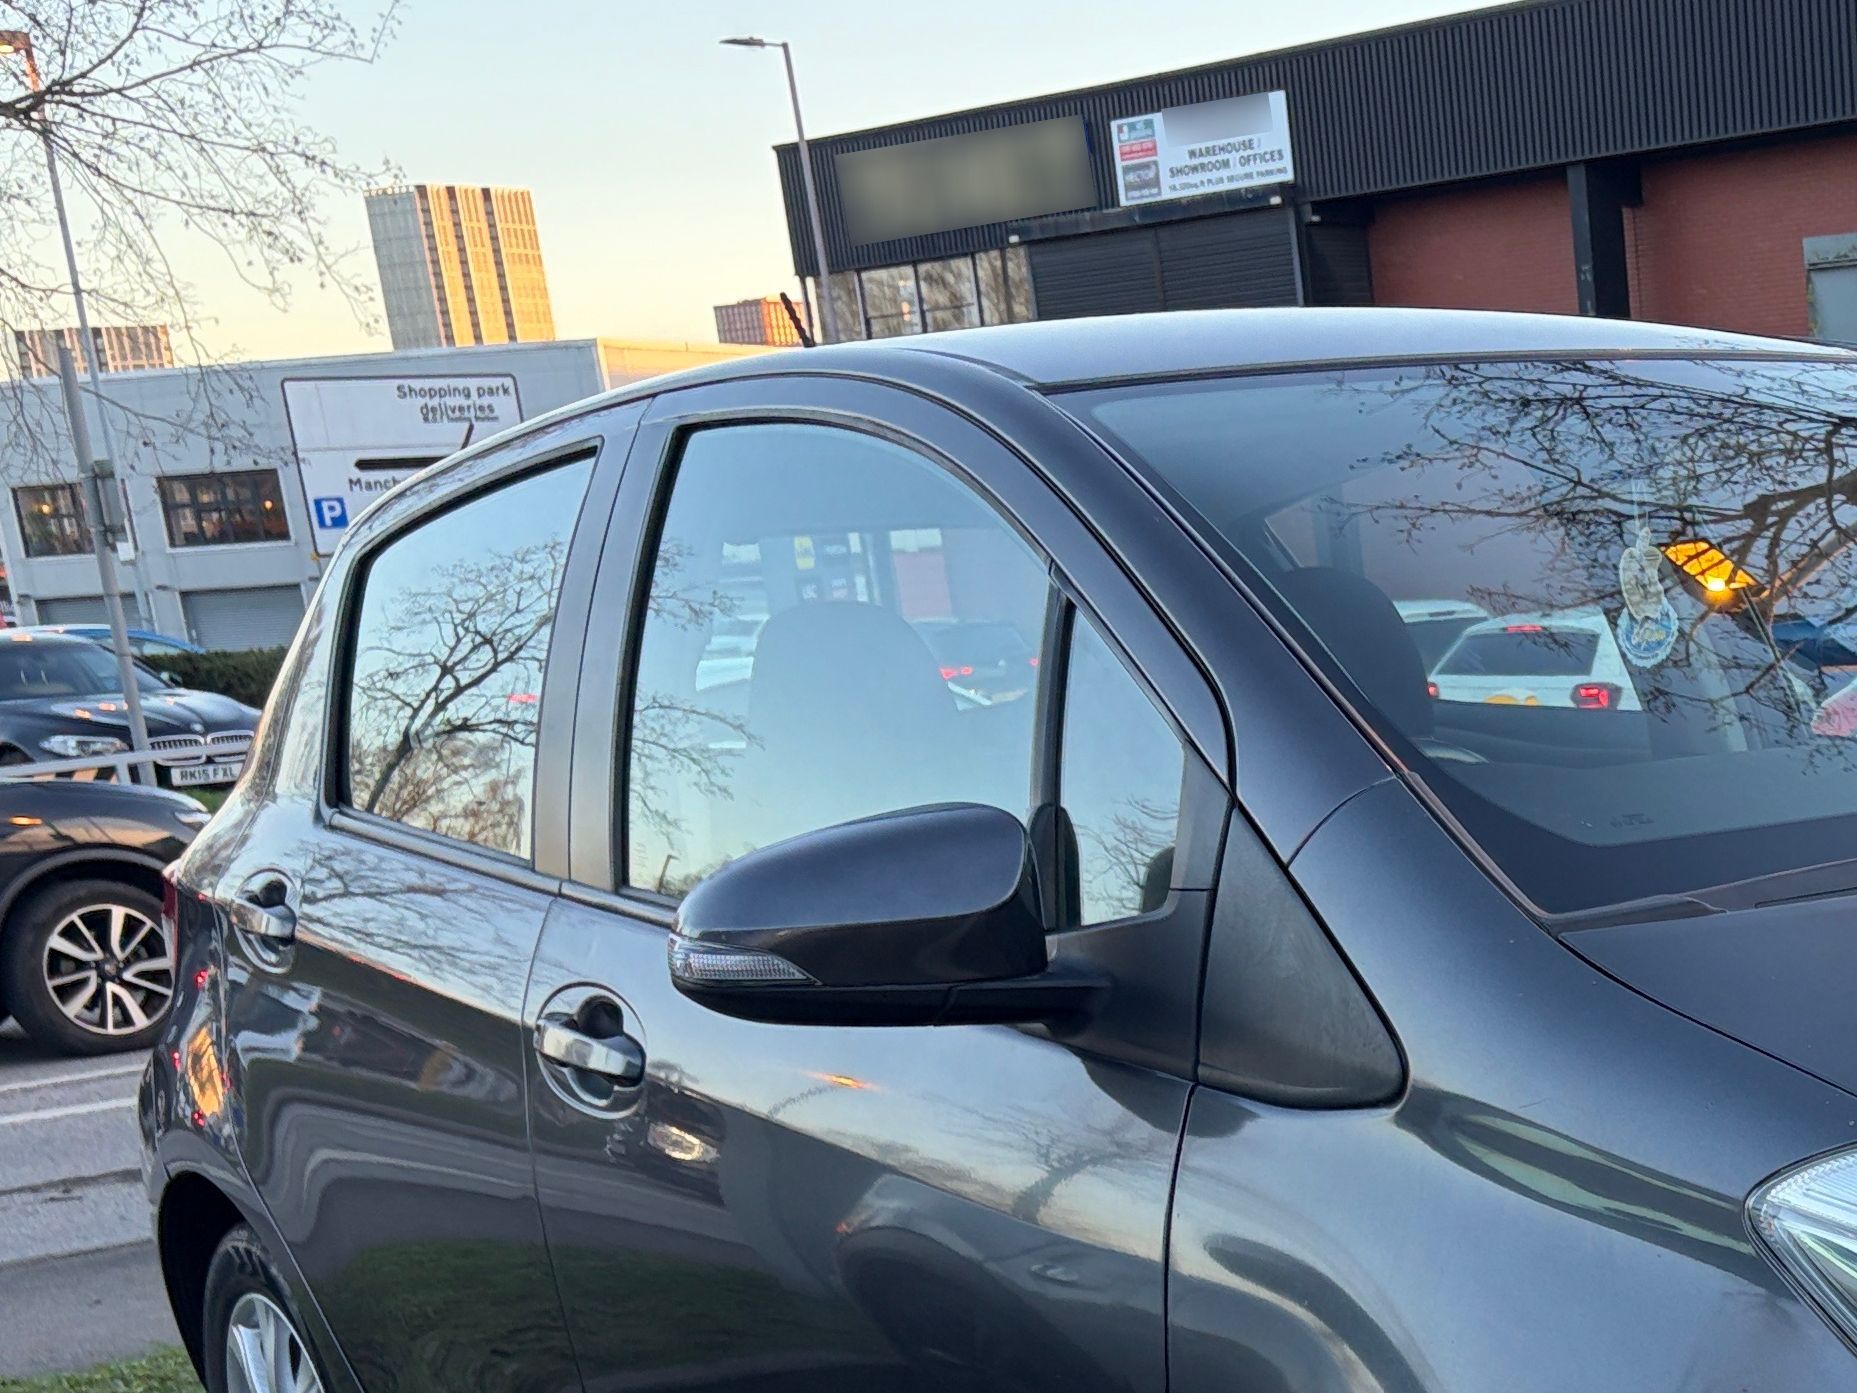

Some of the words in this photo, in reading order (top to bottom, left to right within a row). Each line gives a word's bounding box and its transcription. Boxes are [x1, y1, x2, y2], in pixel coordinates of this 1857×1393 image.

[1187, 138, 1255, 160] WAREHOUSE
[1168, 158, 1231, 179] SHOWROOM
[1238, 149, 1285, 167] OFFICES
[396, 383, 472, 400] Shopping
[476, 382, 511, 399] park
[420, 400, 496, 415] deliveries
[321, 500, 343, 527] P
